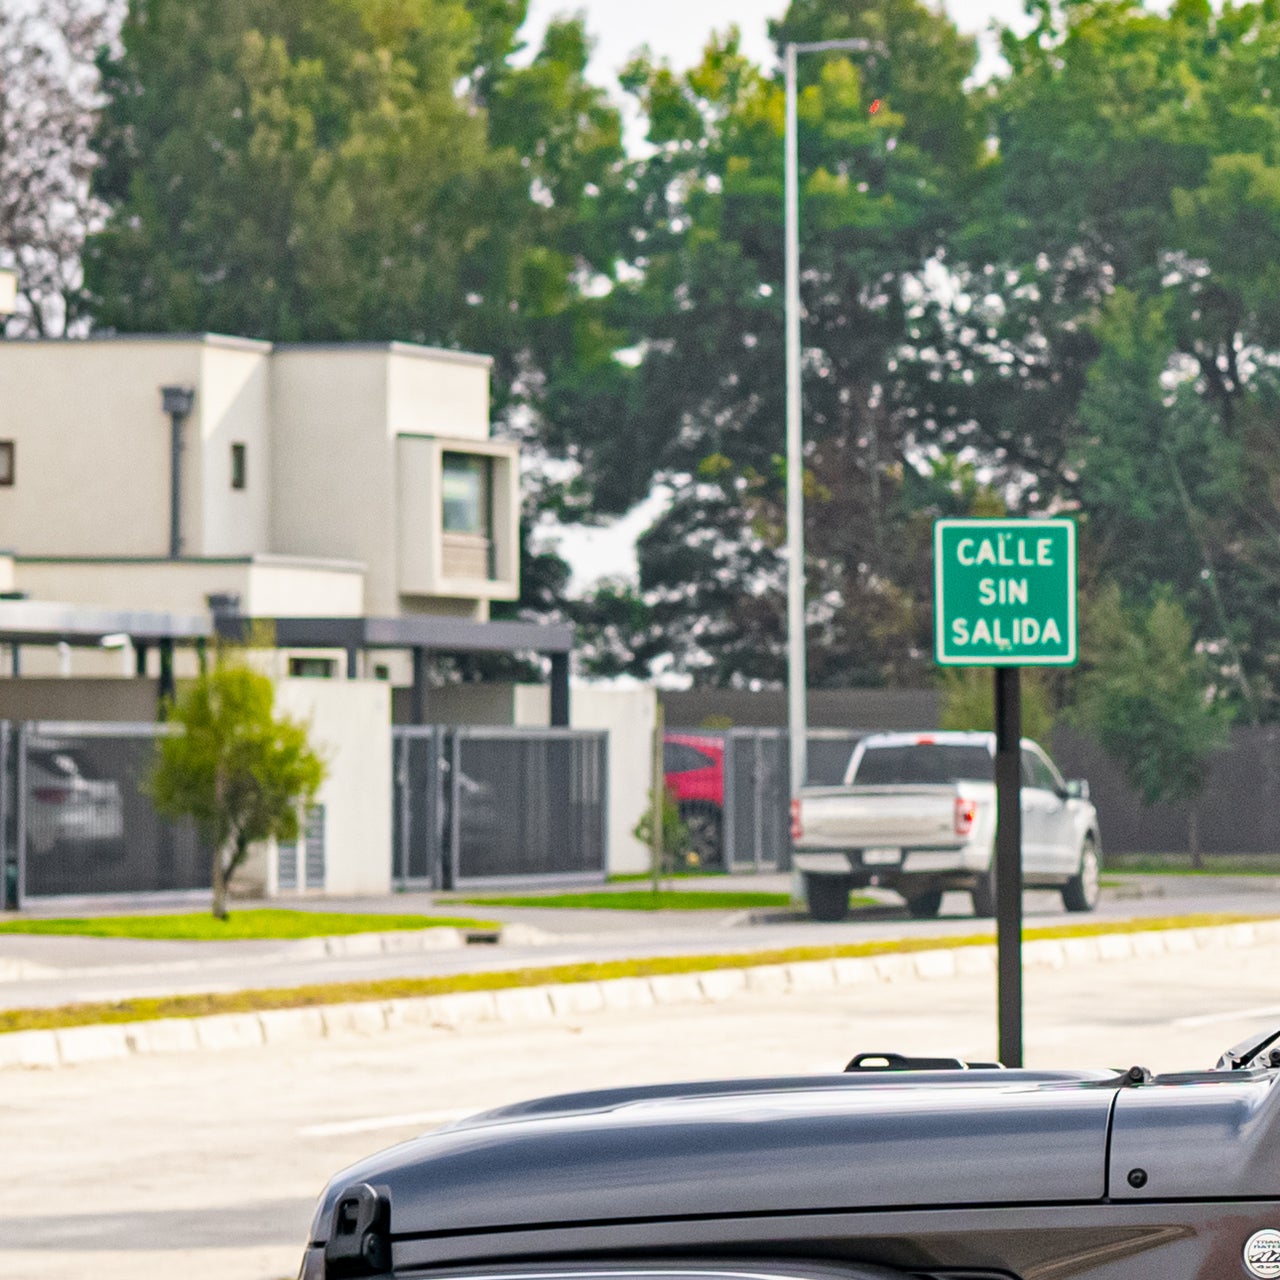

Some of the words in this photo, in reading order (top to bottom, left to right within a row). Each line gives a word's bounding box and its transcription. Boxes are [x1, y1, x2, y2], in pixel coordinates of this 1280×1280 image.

[957, 533, 1054, 567] CALLE
[979, 578, 1028, 606] SIN
[952, 617, 1061, 650] SALIDA
